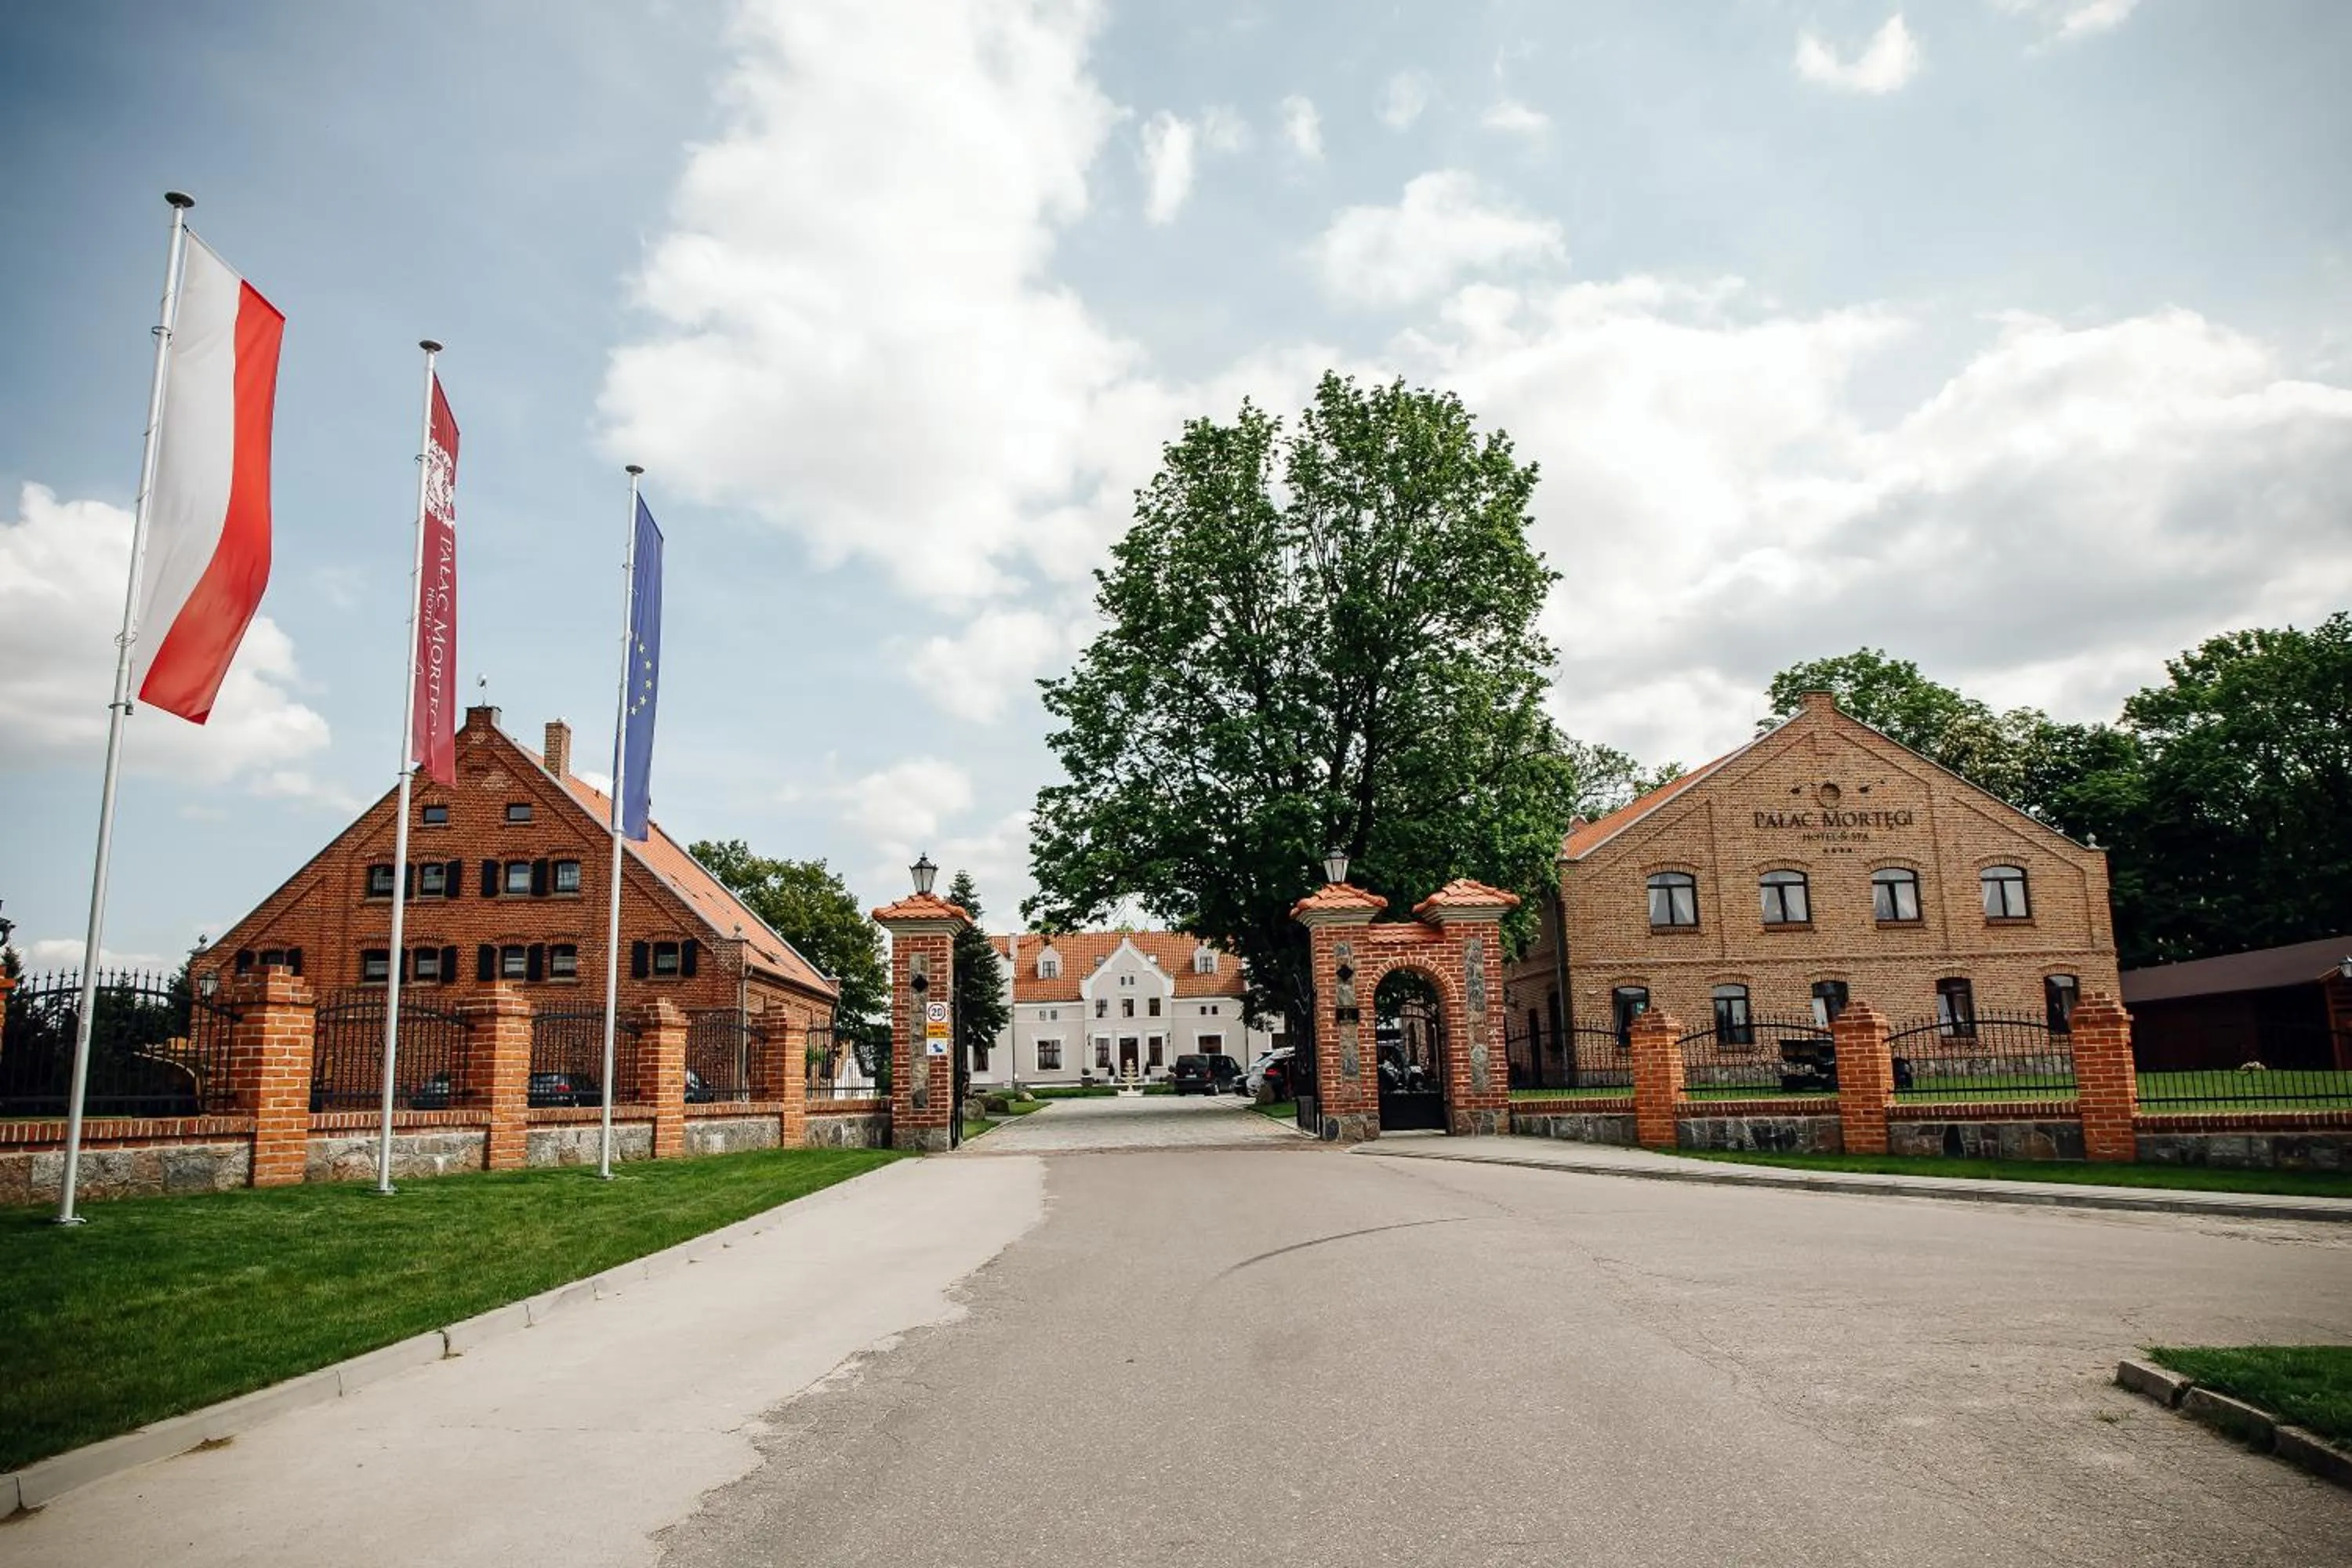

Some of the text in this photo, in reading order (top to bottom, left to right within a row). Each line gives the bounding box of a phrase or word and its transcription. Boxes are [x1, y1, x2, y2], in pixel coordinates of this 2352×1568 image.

[429, 619, 448, 735] MORT
[1803, 833, 1836, 841] HOTEL
[1851, 833, 1870, 841] SPA
[931, 1007, 942, 1016] 20
